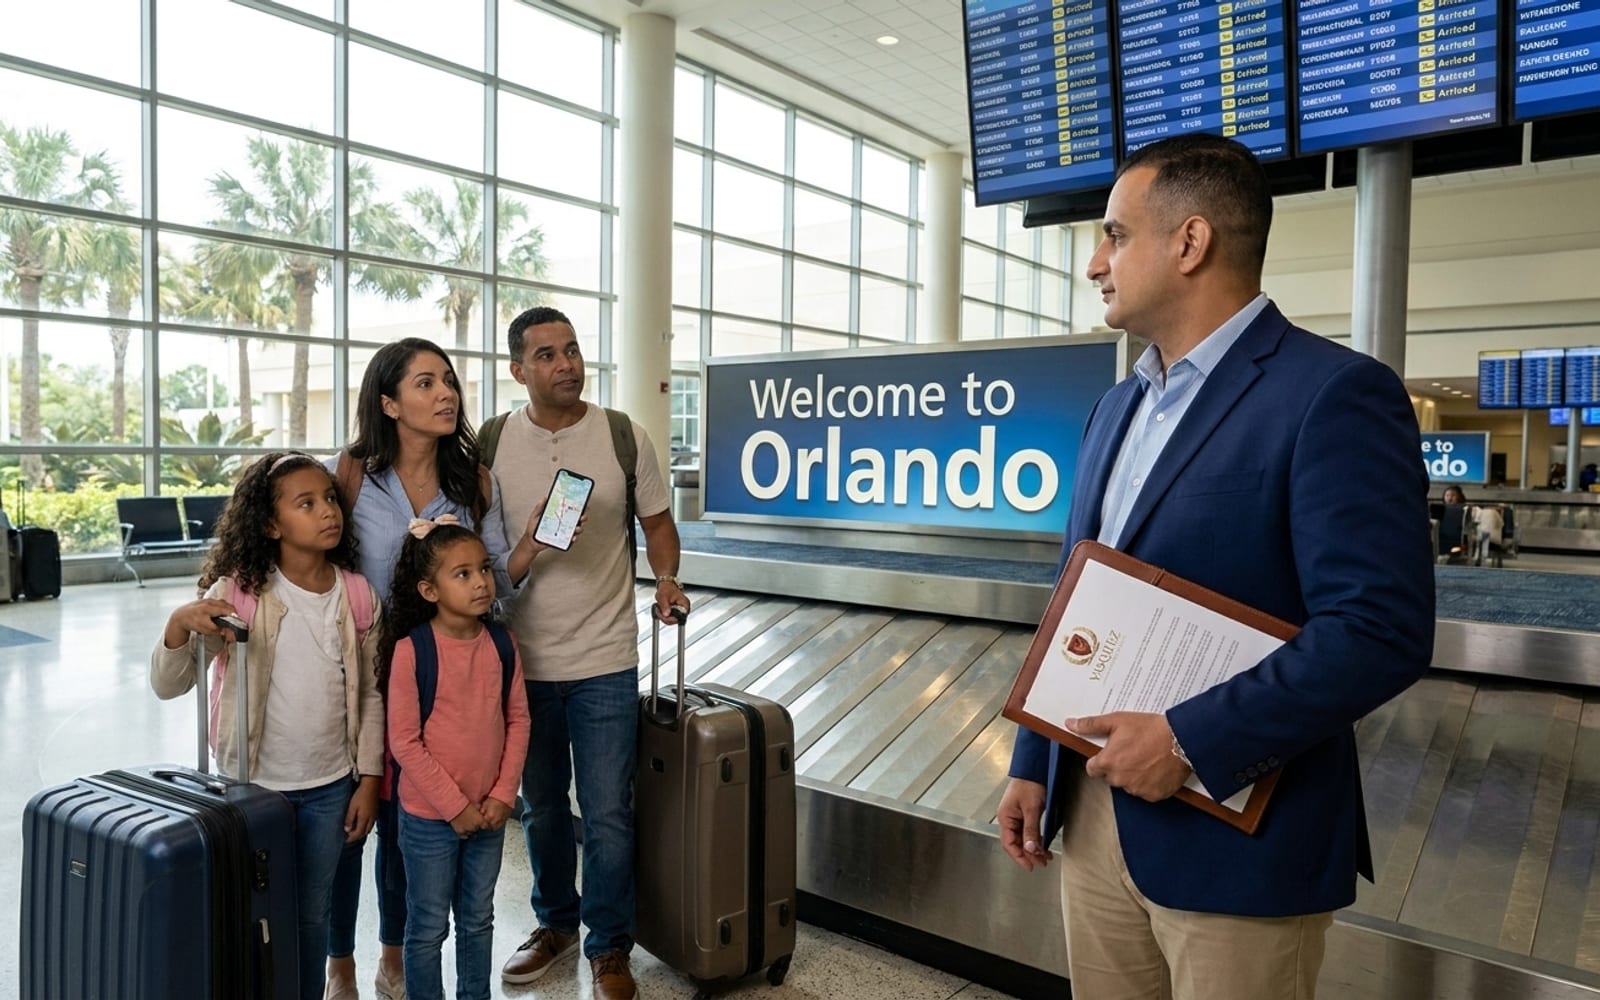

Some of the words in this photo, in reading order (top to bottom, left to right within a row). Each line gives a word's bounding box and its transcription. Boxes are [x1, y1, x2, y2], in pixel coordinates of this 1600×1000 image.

[749, 374, 946, 419] Welcome
[961, 372, 1016, 417] to
[740, 425, 1059, 512] Orlando
[1435, 439, 1454, 453] to
